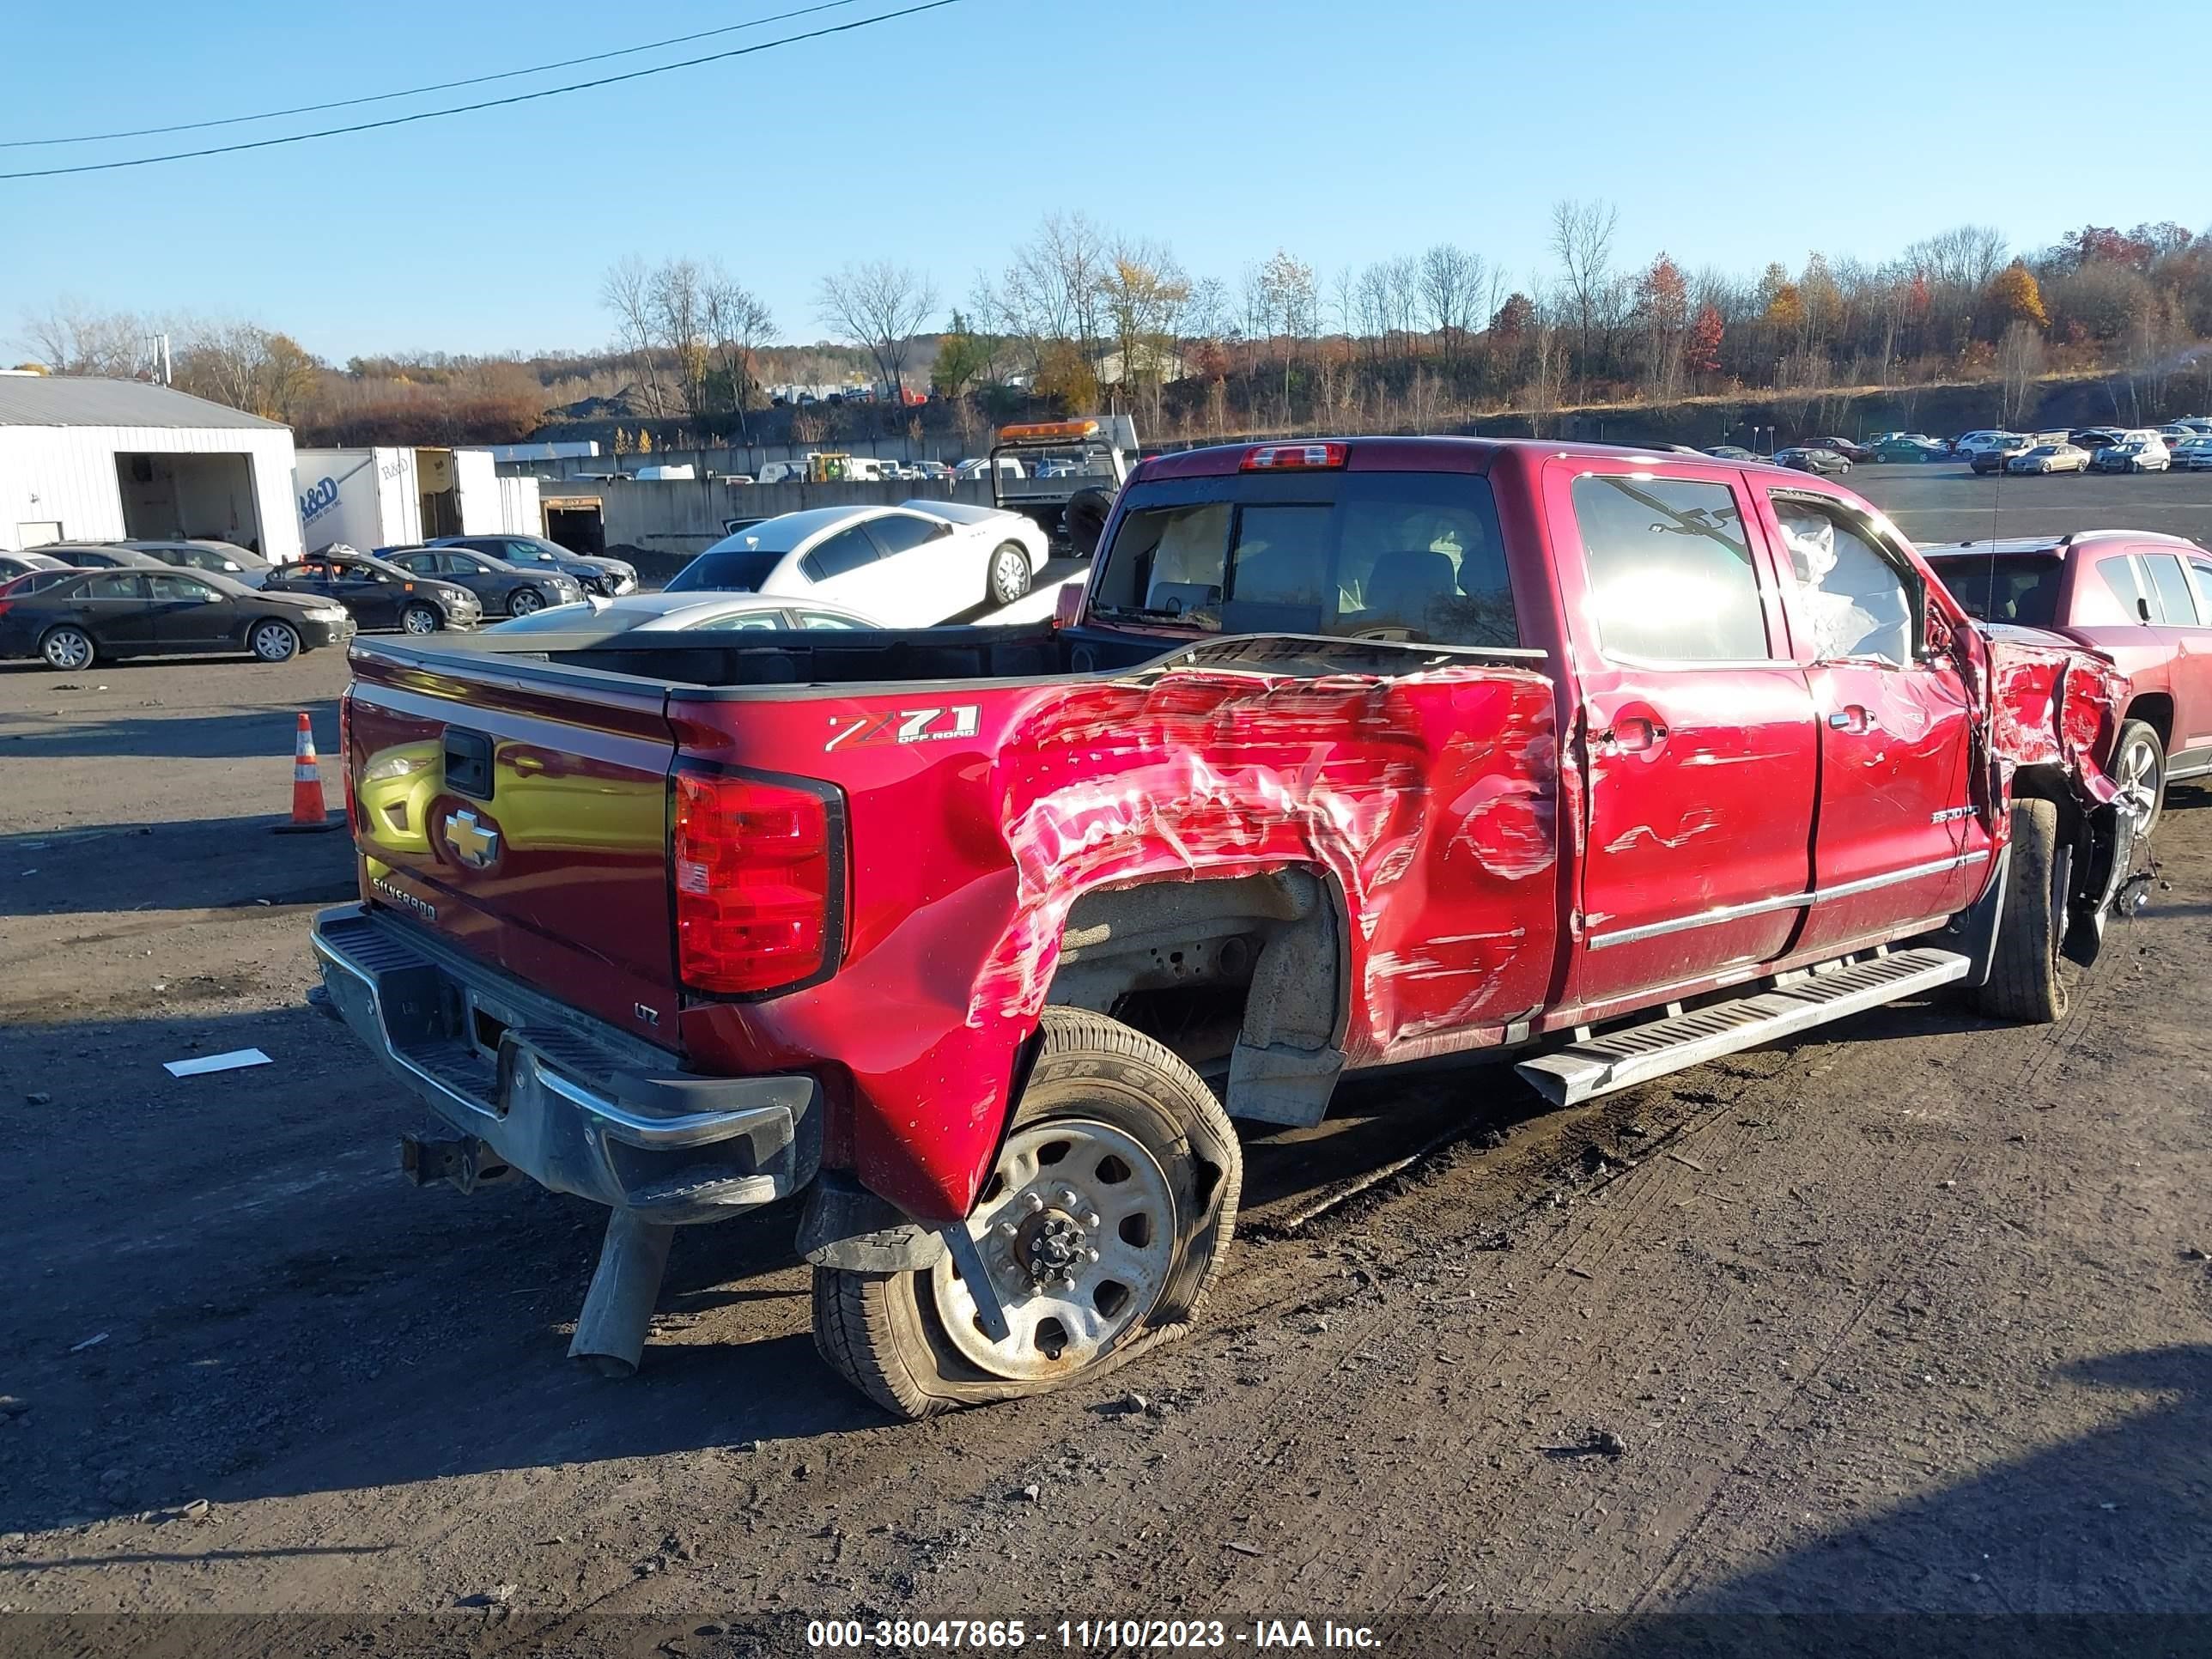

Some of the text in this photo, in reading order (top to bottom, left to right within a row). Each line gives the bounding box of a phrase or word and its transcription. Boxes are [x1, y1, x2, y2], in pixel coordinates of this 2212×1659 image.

[380, 458, 409, 480] R&D
[824, 704, 983, 753] Z71
[897, 730, 976, 744] OFF ROAD
[372, 877, 436, 921] SILVERADO
[634, 1001, 659, 1027] LTZ
